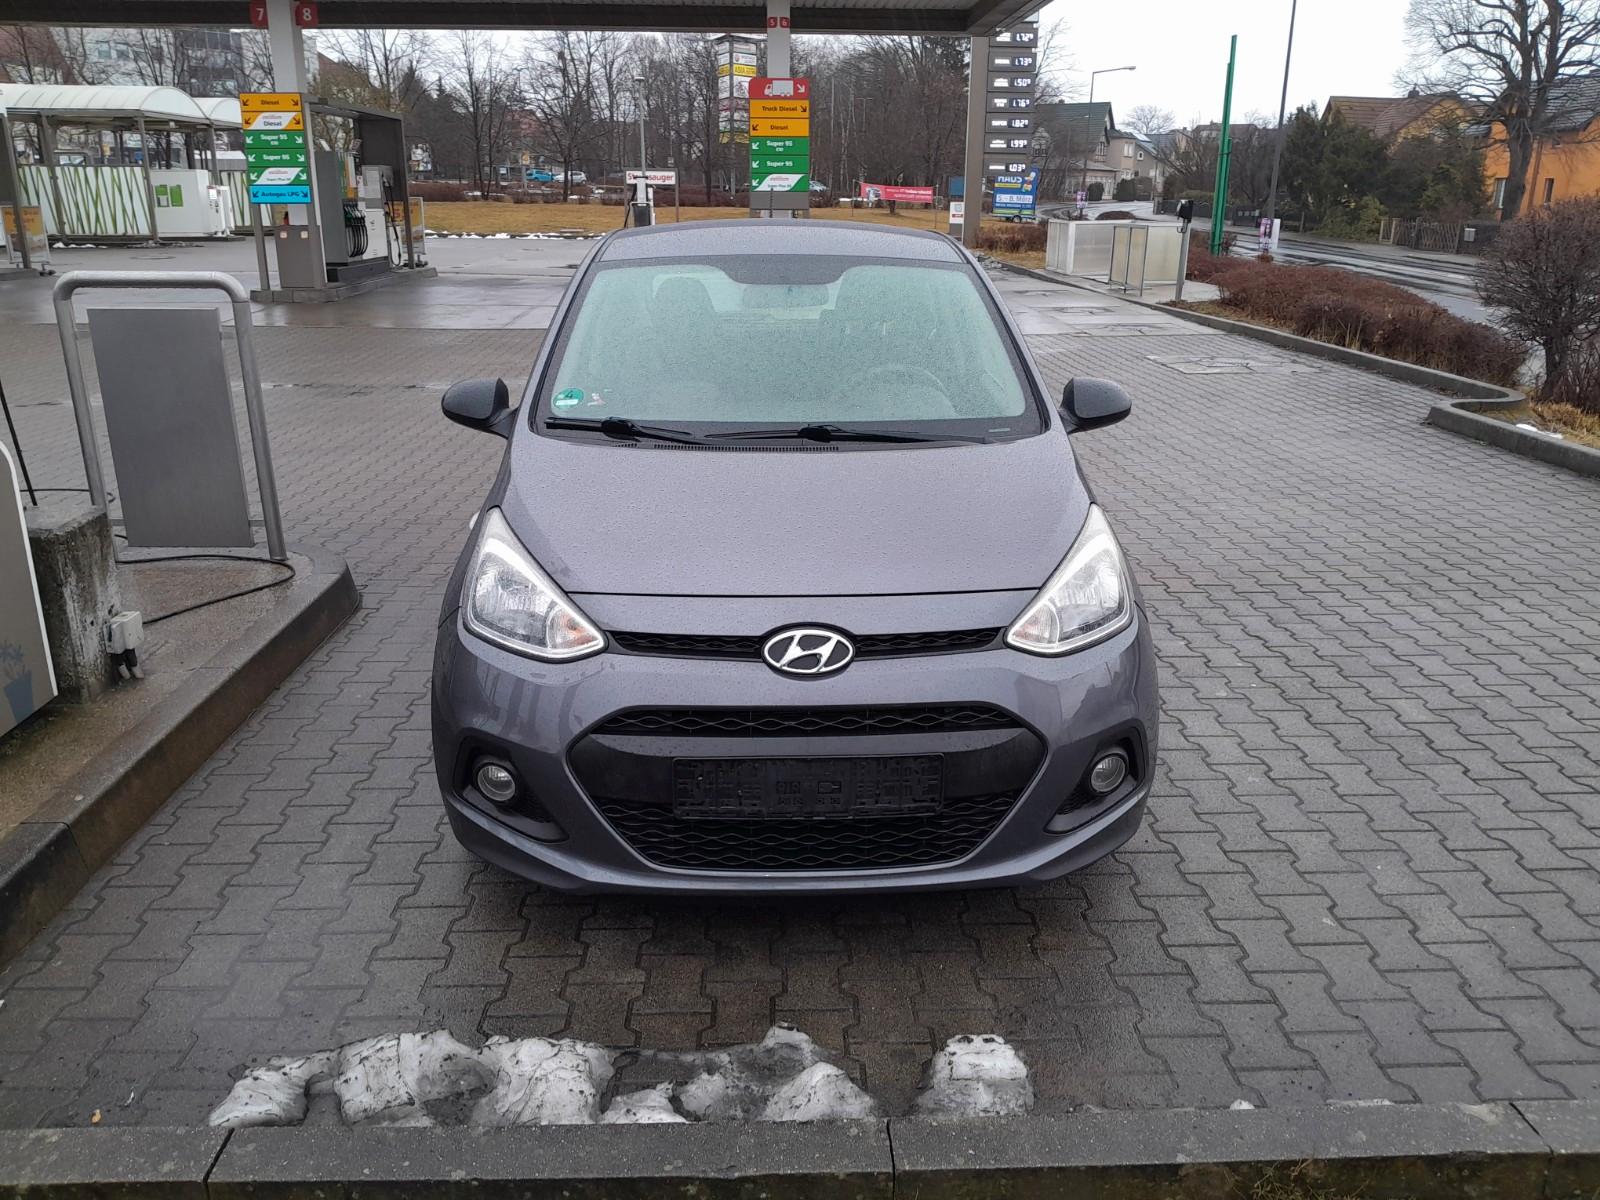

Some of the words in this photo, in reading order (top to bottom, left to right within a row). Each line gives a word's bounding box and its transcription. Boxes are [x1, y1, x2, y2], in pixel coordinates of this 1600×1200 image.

[256, 8, 264, 21] 7
[303, 7, 312, 21] 8
[766, 160, 784, 168] Super
[261, 191, 287, 199] Autogas
[564, 390, 574, 399] 4
